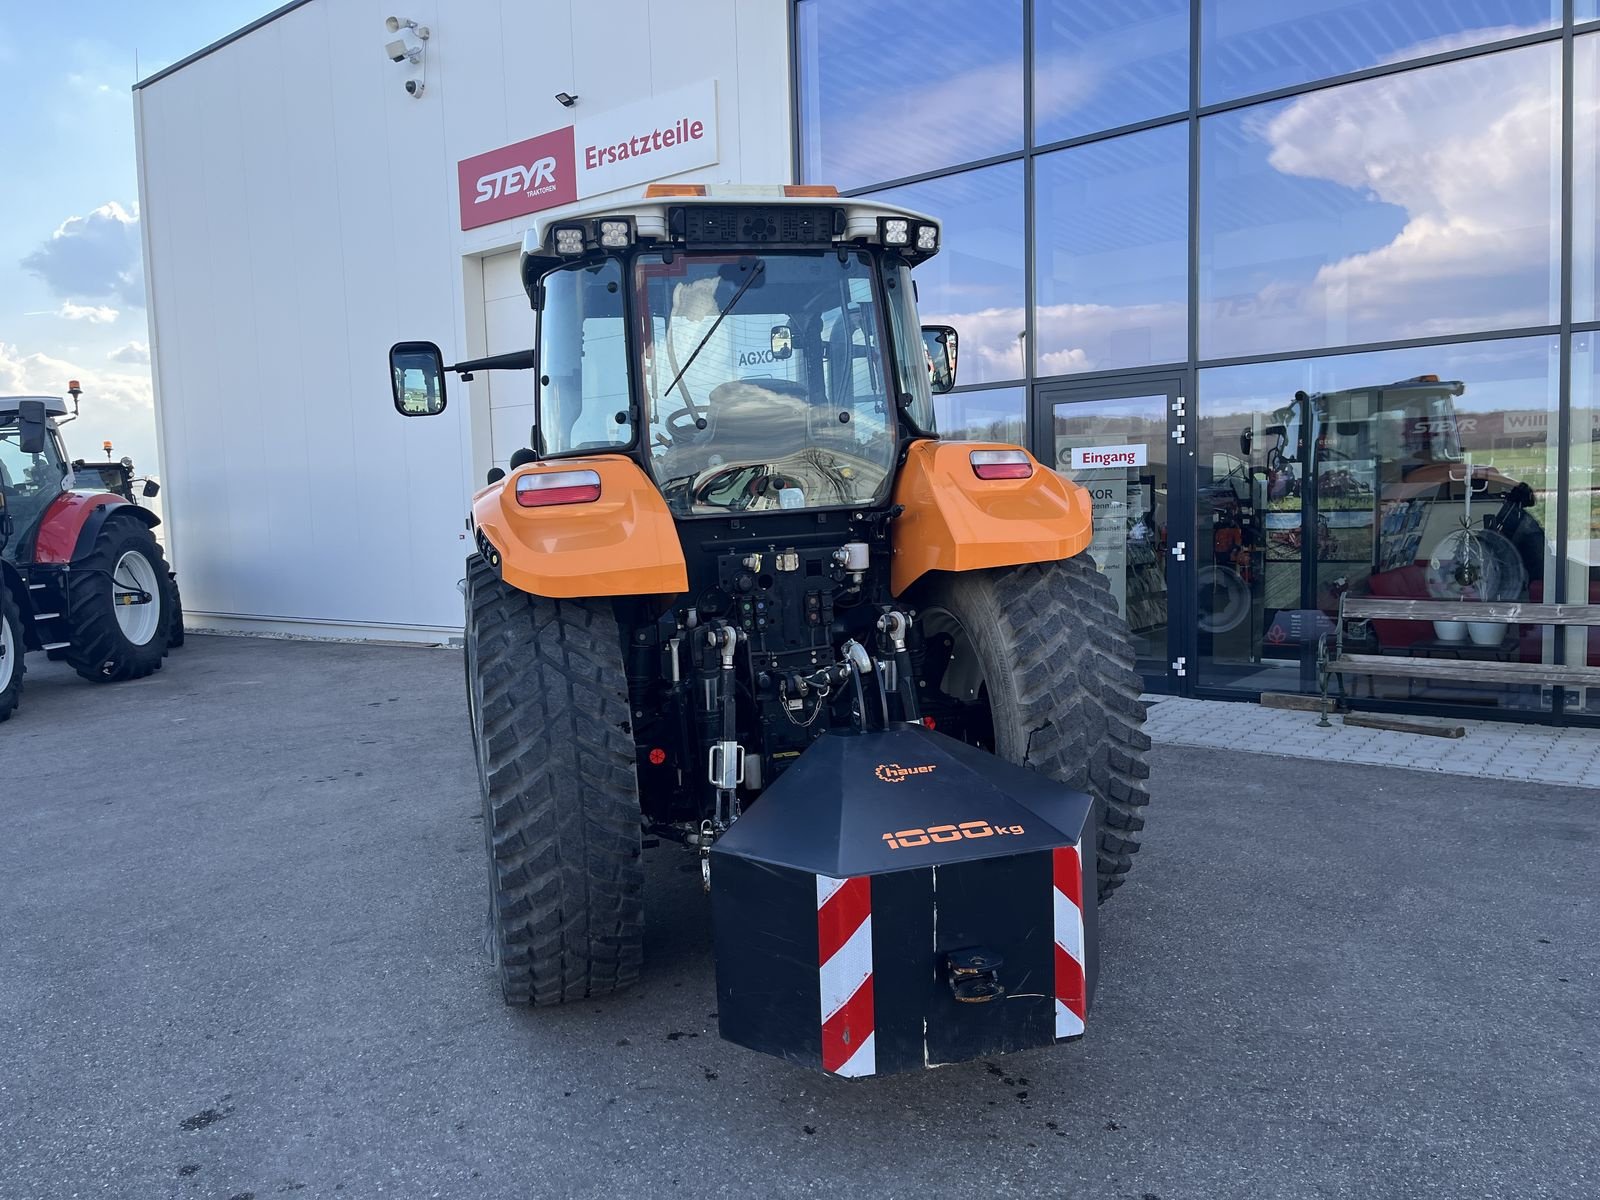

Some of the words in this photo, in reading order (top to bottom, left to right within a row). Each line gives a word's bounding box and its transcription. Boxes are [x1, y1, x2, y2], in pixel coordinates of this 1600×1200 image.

[585, 118, 704, 170] Ersatzteile
[474, 156, 557, 204] STEYR
[527, 184, 557, 198] TRAKTOREN
[738, 349, 785, 367] AGXO
[1412, 418, 1478, 434] STEYR
[1082, 451, 1136, 466] Eingang
[1089, 489, 1113, 500] XOR
[884, 765, 937, 777] hauer
